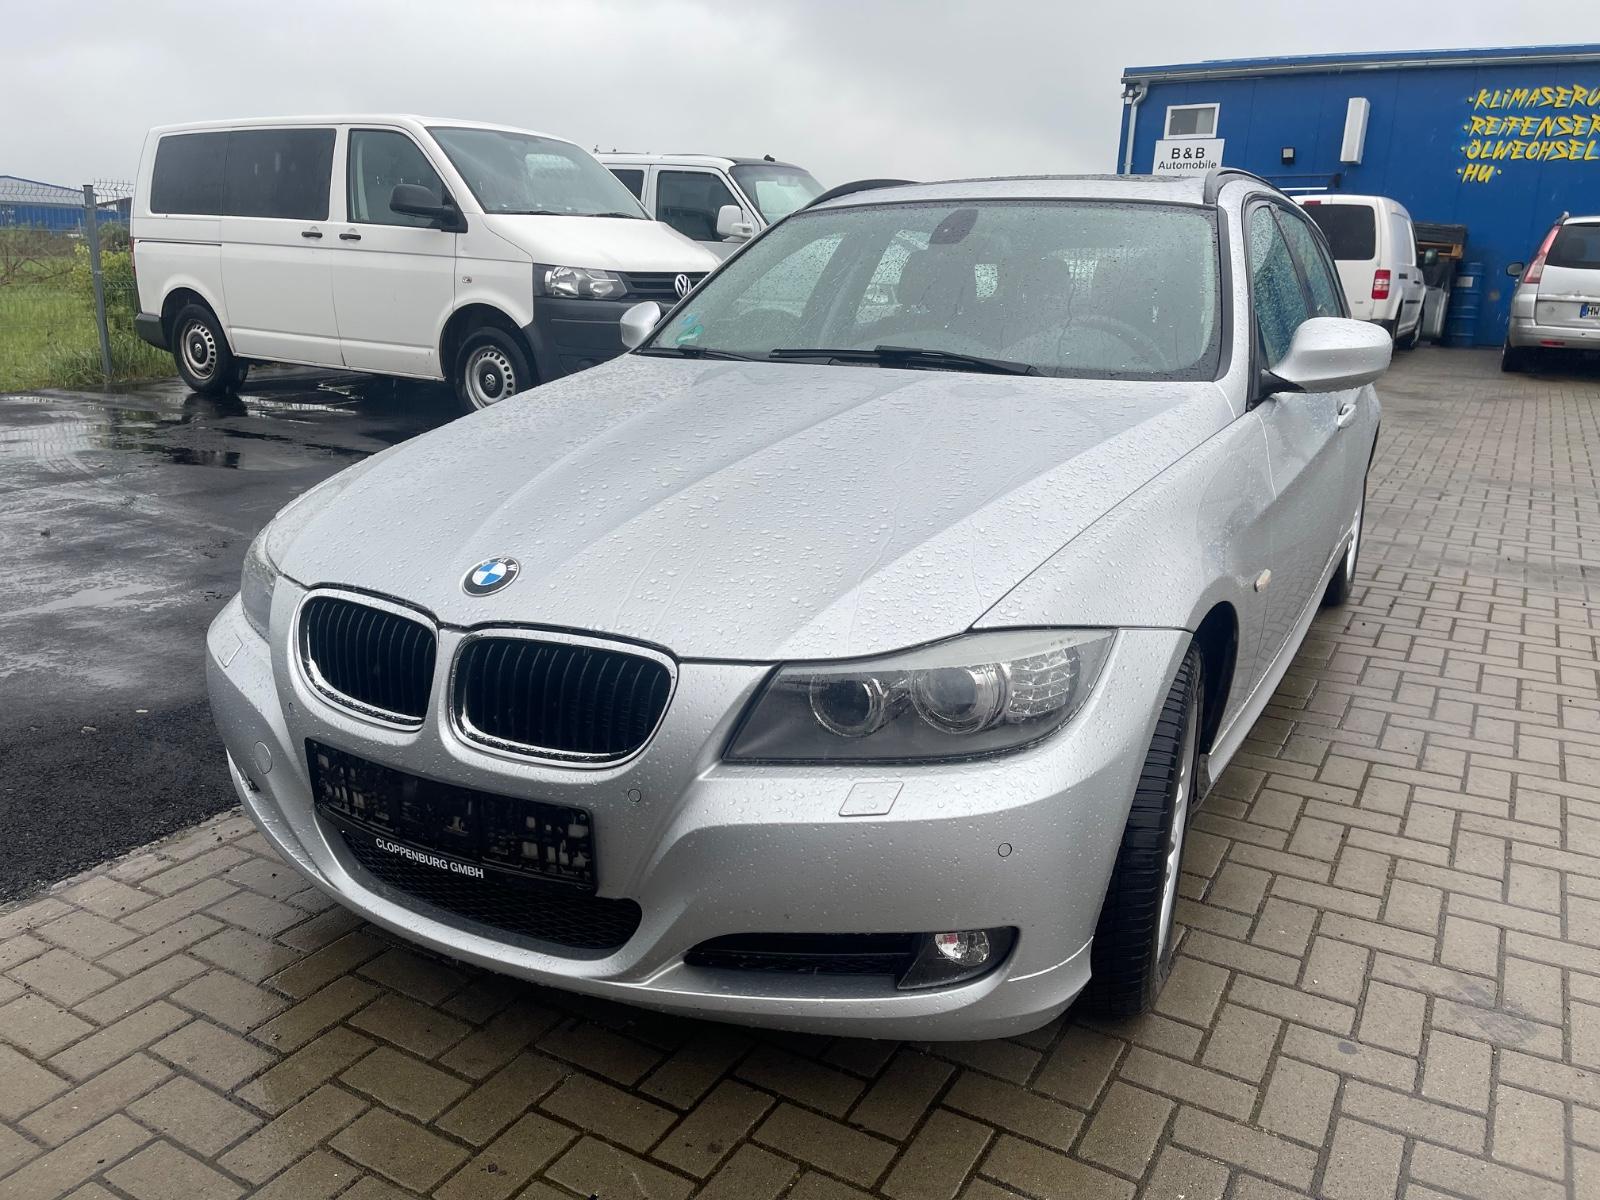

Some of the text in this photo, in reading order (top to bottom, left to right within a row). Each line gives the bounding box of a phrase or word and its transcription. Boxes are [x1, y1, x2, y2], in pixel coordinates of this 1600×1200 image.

[1171, 147, 1205, 159] B & B
[1157, 160, 1217, 170] Automobile
[1462, 163, 1495, 183] HU
[376, 838, 484, 879] CLOPPENBURG GMBH
